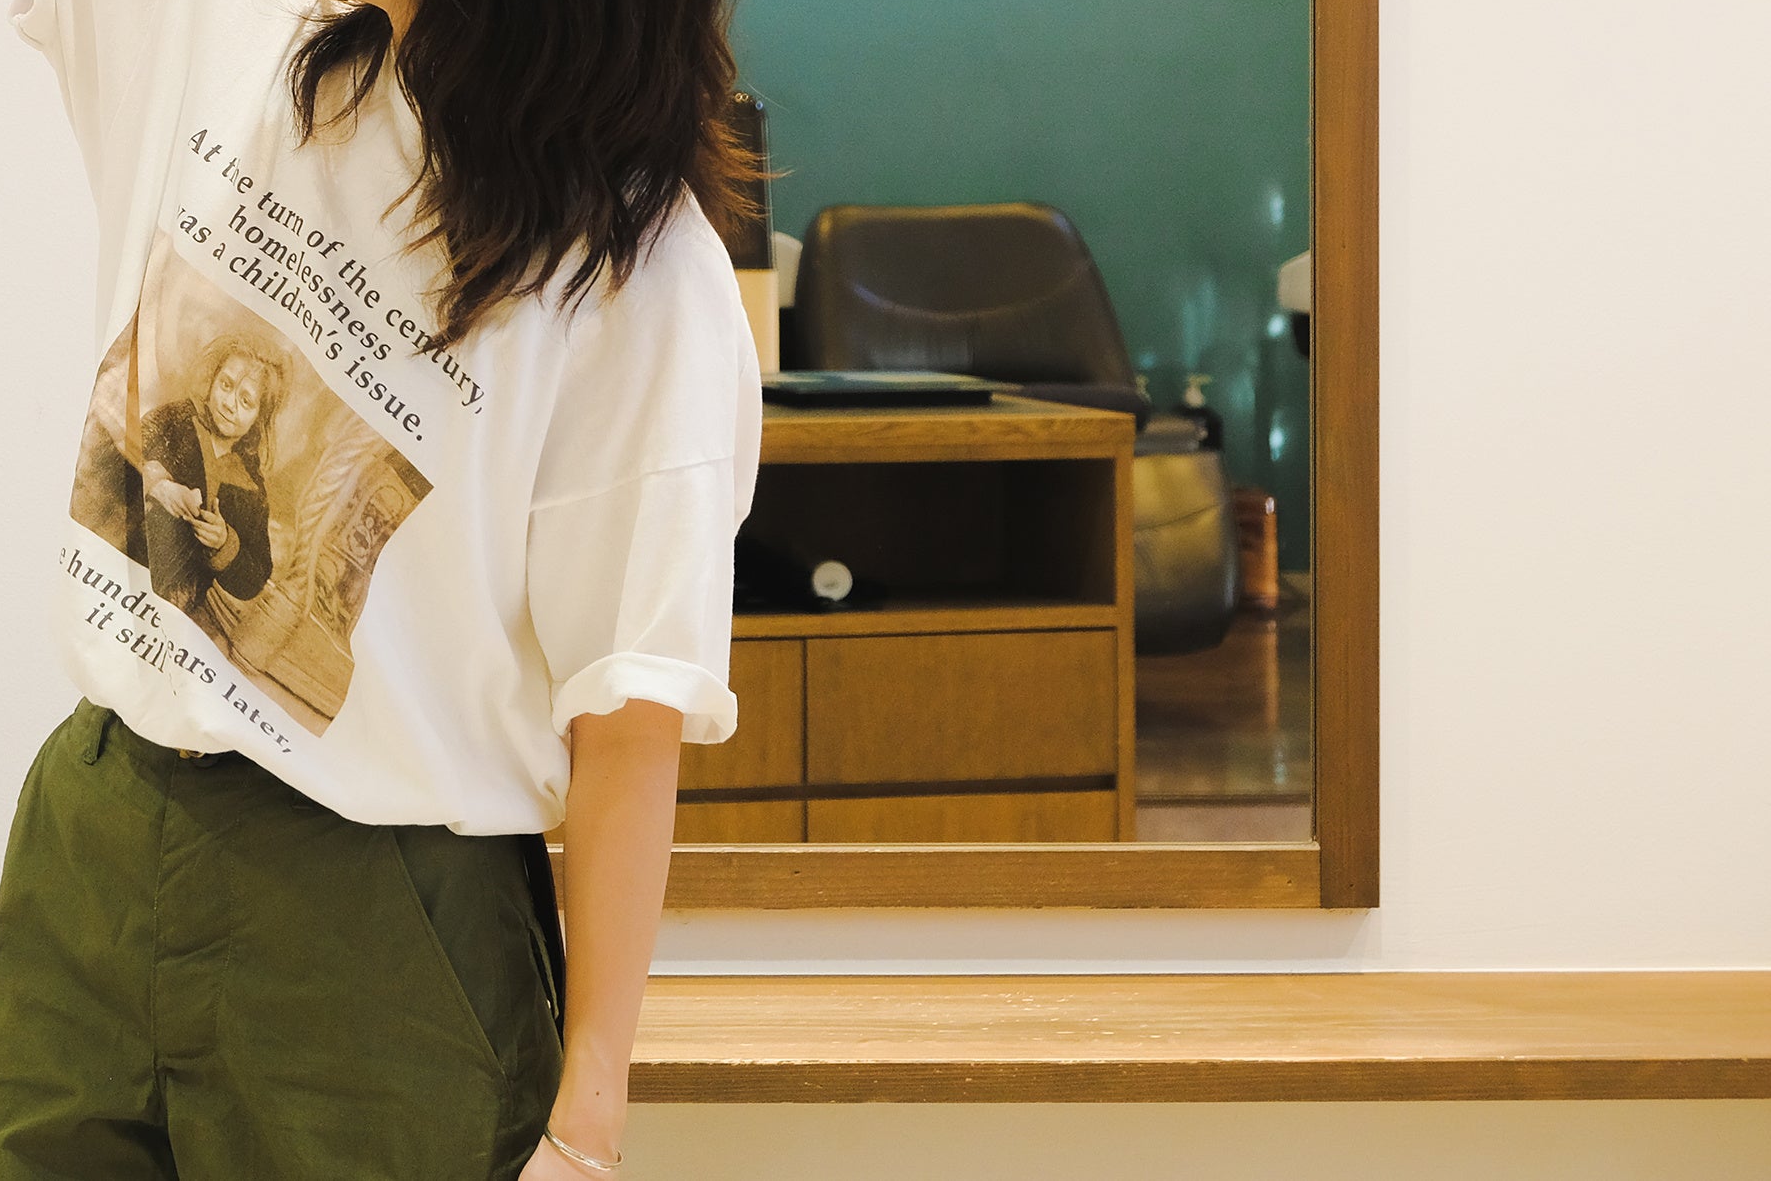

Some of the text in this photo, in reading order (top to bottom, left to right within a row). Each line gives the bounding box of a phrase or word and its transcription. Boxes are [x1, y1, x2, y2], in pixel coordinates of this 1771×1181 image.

[187, 128, 485, 415] At the turn of the century,
[212, 242, 226, 261] a
[229, 256, 344, 362] children's
[344, 356, 424, 442] issue.
[228, 204, 392, 361] homelessness
[85, 602, 165, 674] it still
[167, 640, 217, 684] ears
[222, 682, 292, 754] later,
